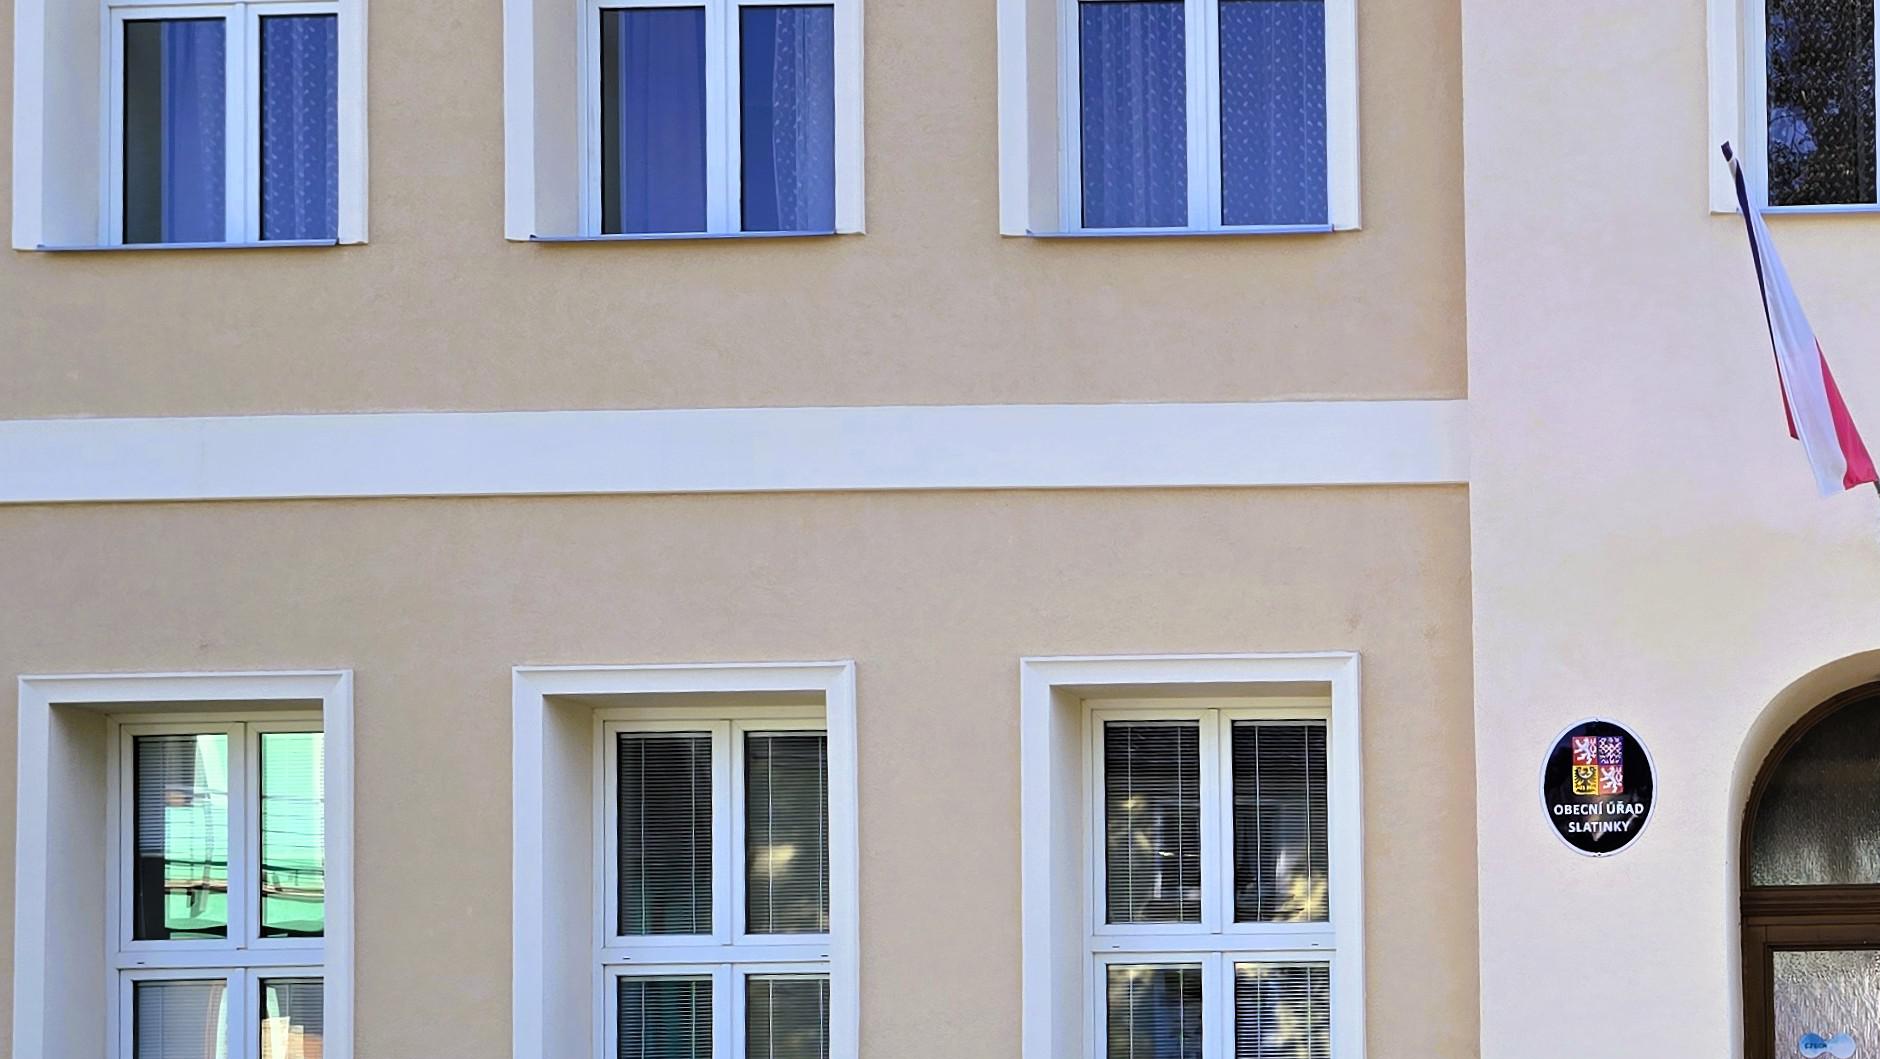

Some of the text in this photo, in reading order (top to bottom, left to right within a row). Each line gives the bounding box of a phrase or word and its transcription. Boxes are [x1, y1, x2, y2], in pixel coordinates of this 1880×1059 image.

[1553, 800, 1645, 815] OBECNÍ ÚŘAD
[1568, 821, 1630, 832] SLATINKY
